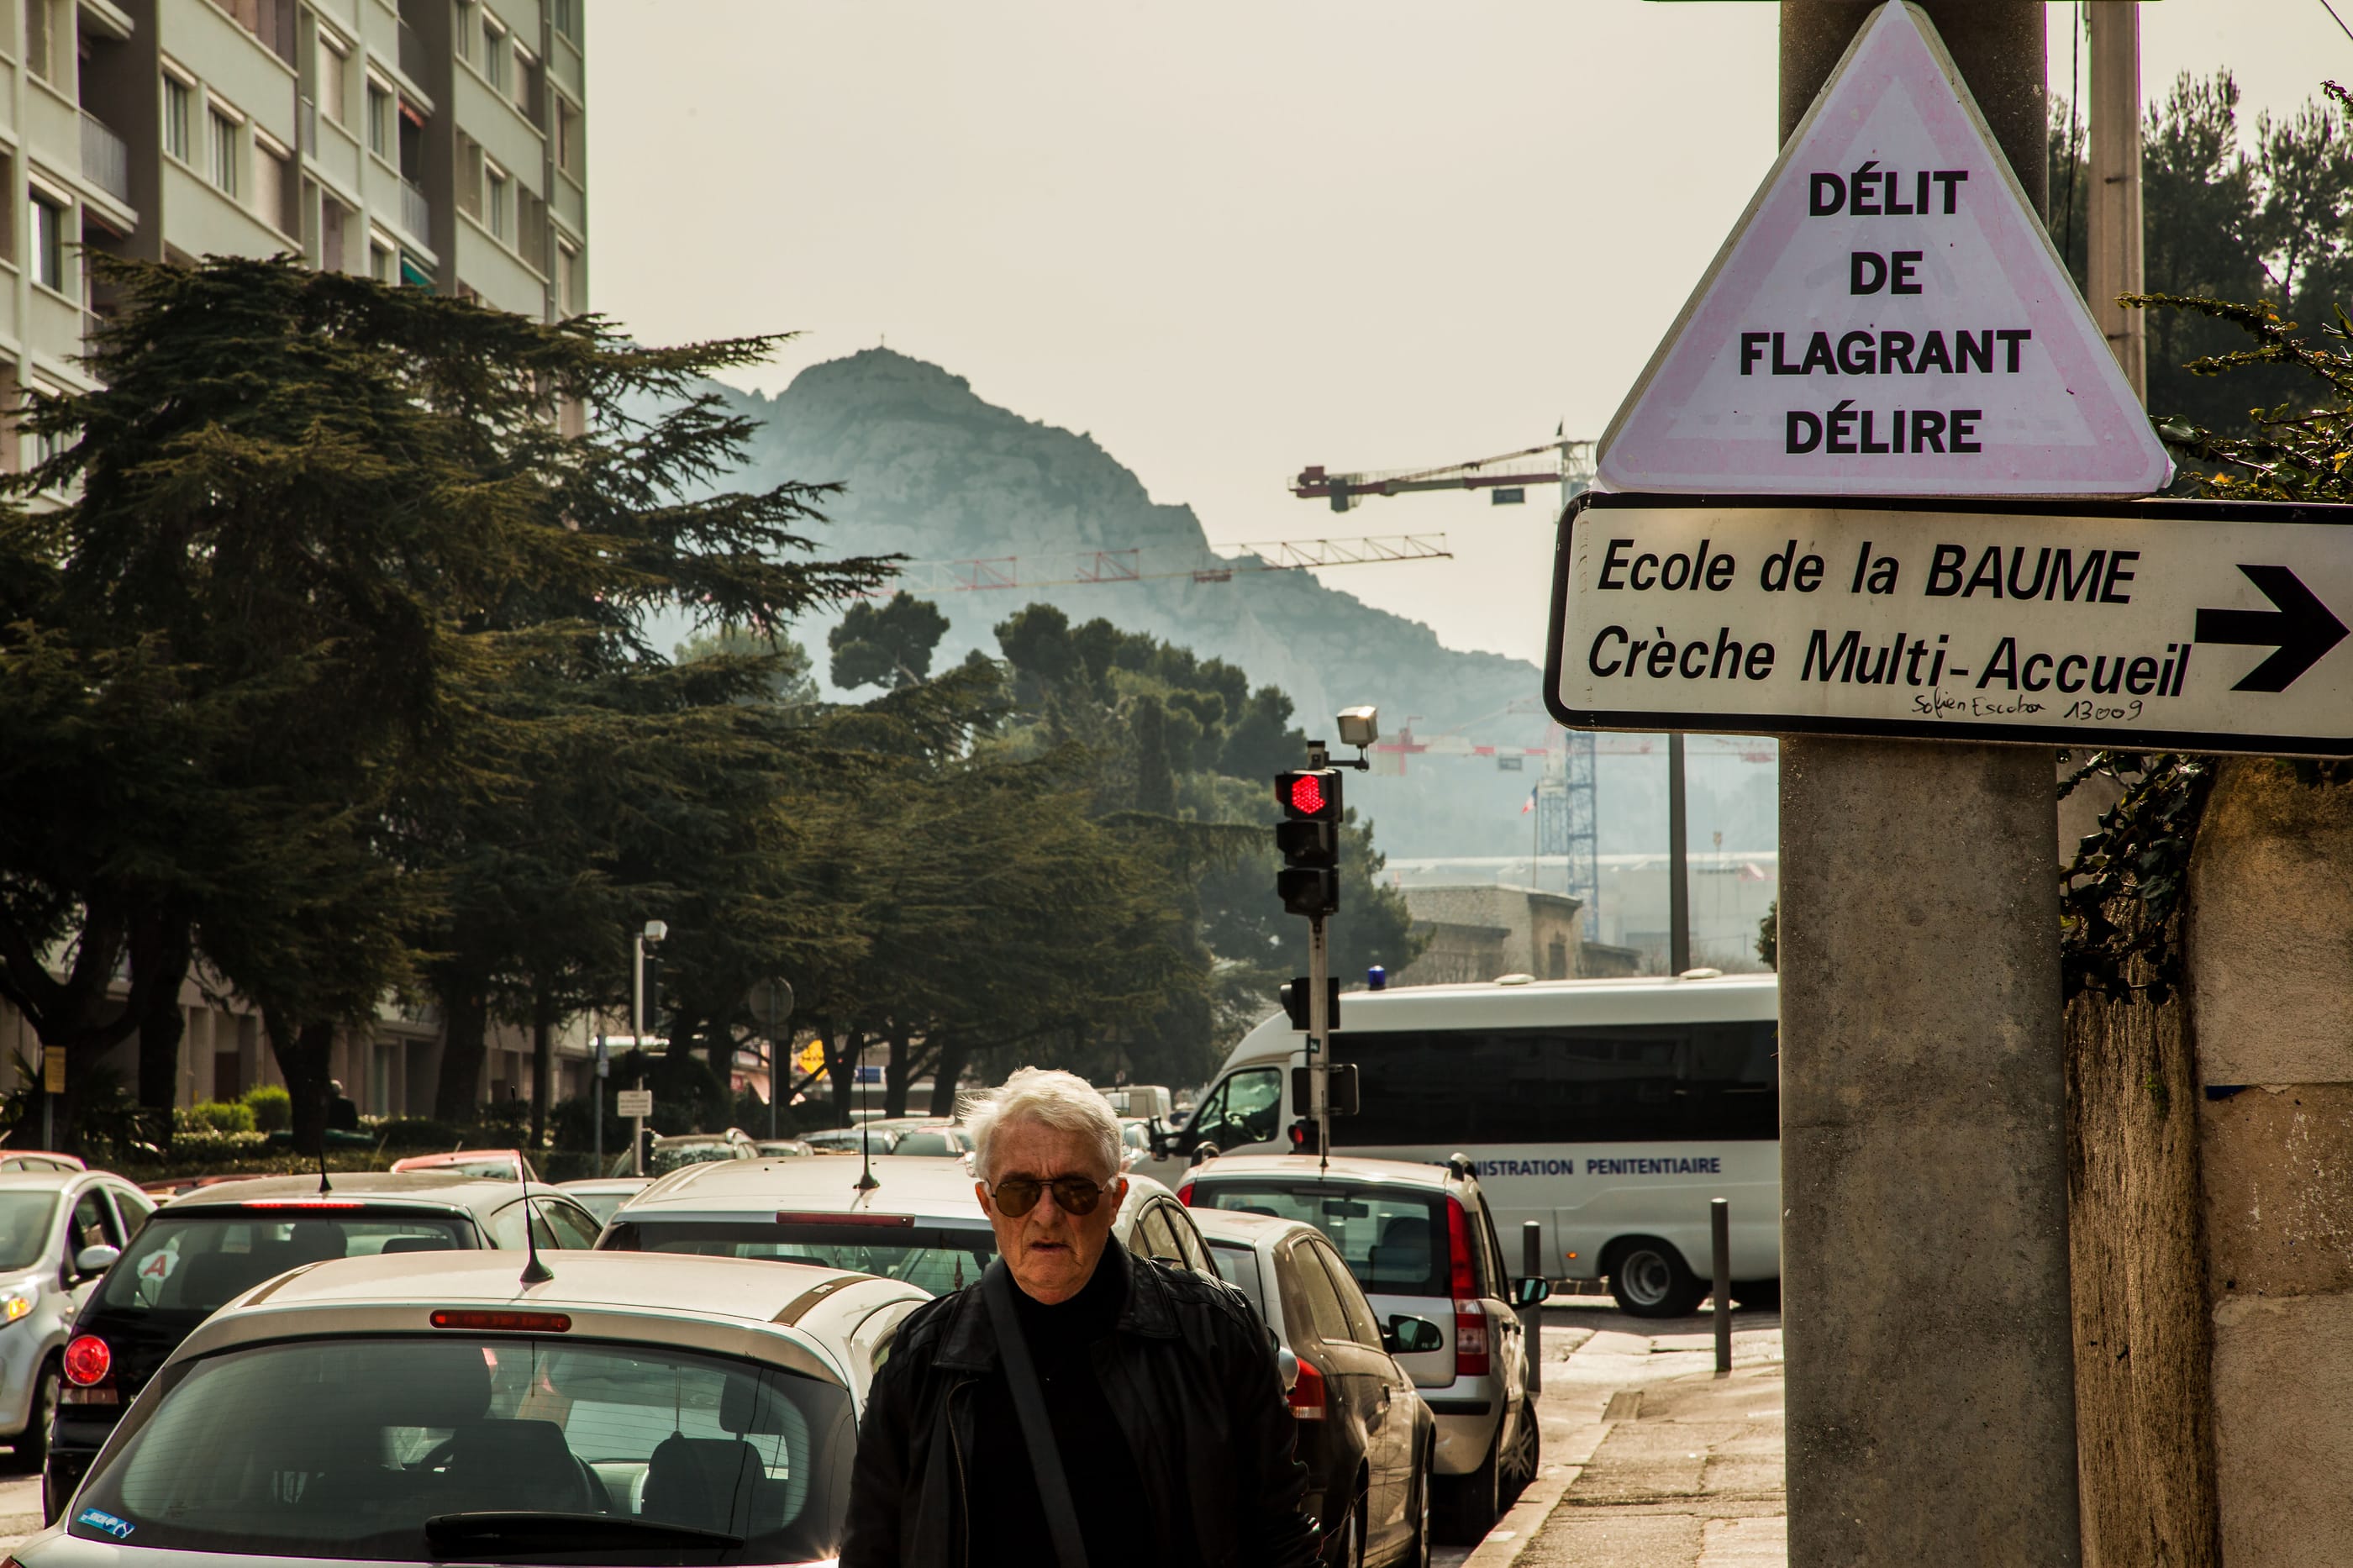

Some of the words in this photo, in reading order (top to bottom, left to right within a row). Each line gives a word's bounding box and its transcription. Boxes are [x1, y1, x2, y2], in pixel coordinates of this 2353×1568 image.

[1810, 161, 1968, 216] DÉLIT
[1850, 251, 1923, 295] DE
[1740, 329, 2031, 376] FLAGRANT
[1786, 400, 1982, 455] DÉLIRE
[1598, 539, 1734, 592] Ecole
[1761, 539, 1824, 593] de
[1851, 540, 1899, 595] la
[1924, 544, 2140, 605] BAUME
[1588, 625, 1775, 681] Crèche
[1801, 629, 2191, 697] Multi-Accueil
[2063, 700, 2144, 721] 13009
[1587, 1157, 1721, 1175] PENITENTIAIRE
[142, 1255, 167, 1277] A
